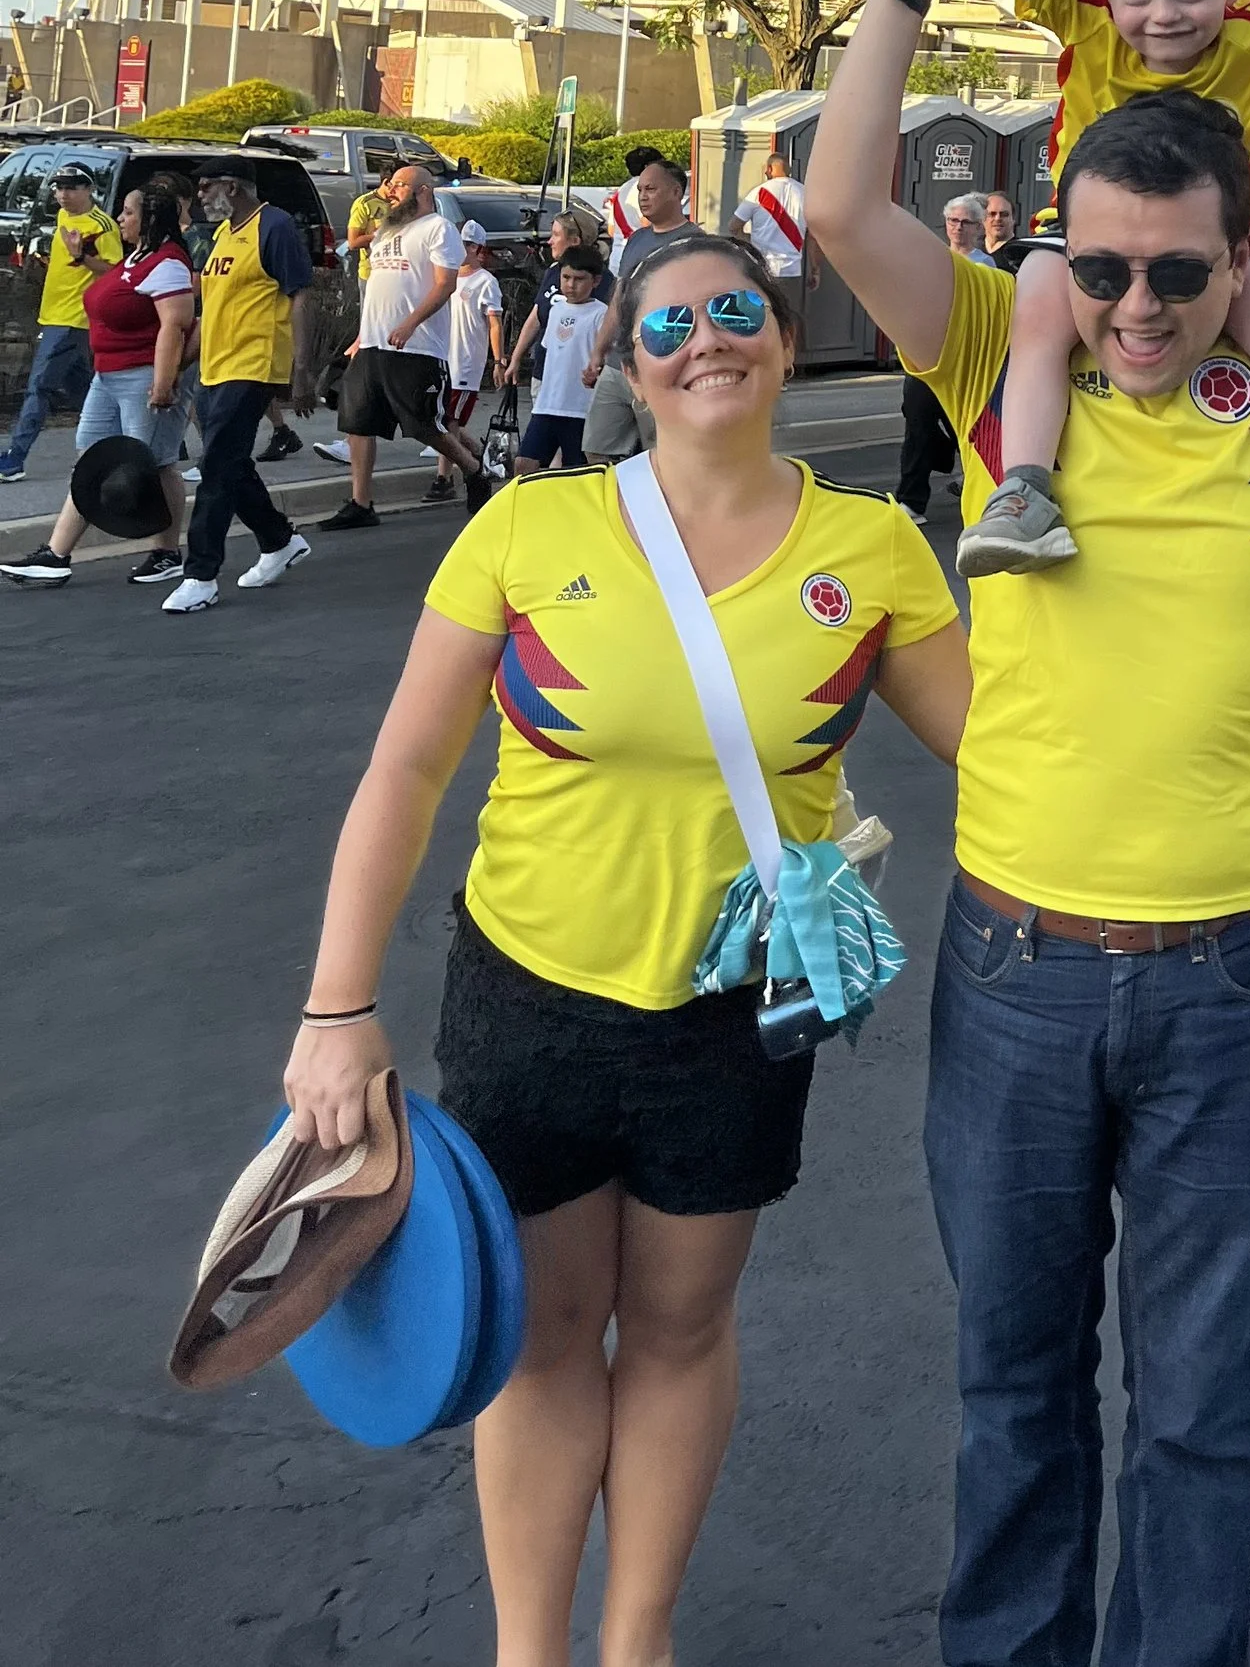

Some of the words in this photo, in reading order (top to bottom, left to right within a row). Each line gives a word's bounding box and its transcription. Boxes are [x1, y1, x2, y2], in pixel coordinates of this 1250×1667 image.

[935, 156, 970, 167] JOHNS
[203, 256, 235, 276] JVC
[555, 590, 598, 601] adidas
